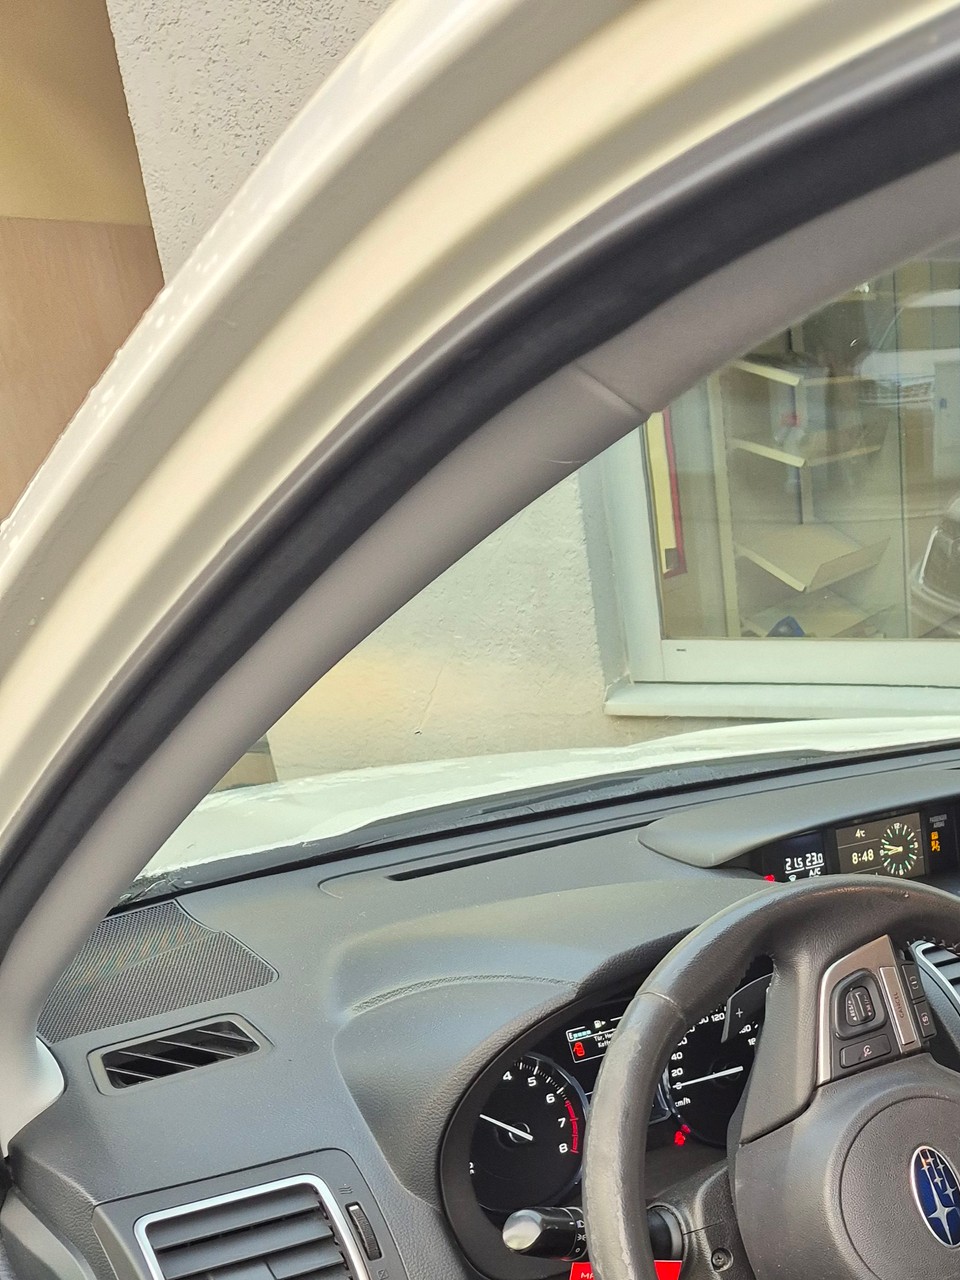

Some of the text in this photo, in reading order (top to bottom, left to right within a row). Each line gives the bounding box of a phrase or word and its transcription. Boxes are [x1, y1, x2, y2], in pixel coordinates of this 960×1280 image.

[852, 849, 874, 864] 8:48
[711, 1012, 725, 1023] 120
[671, 1052, 683, 1061] 40
[502, 1071, 513, 1080] 4
[671, 1067, 683, 1077] 20
[527, 1076, 537, 1087] 5
[546, 1093, 555, 1104] 6
[558, 1117, 566, 1128] 7
[559, 1143, 568, 1154] 8
